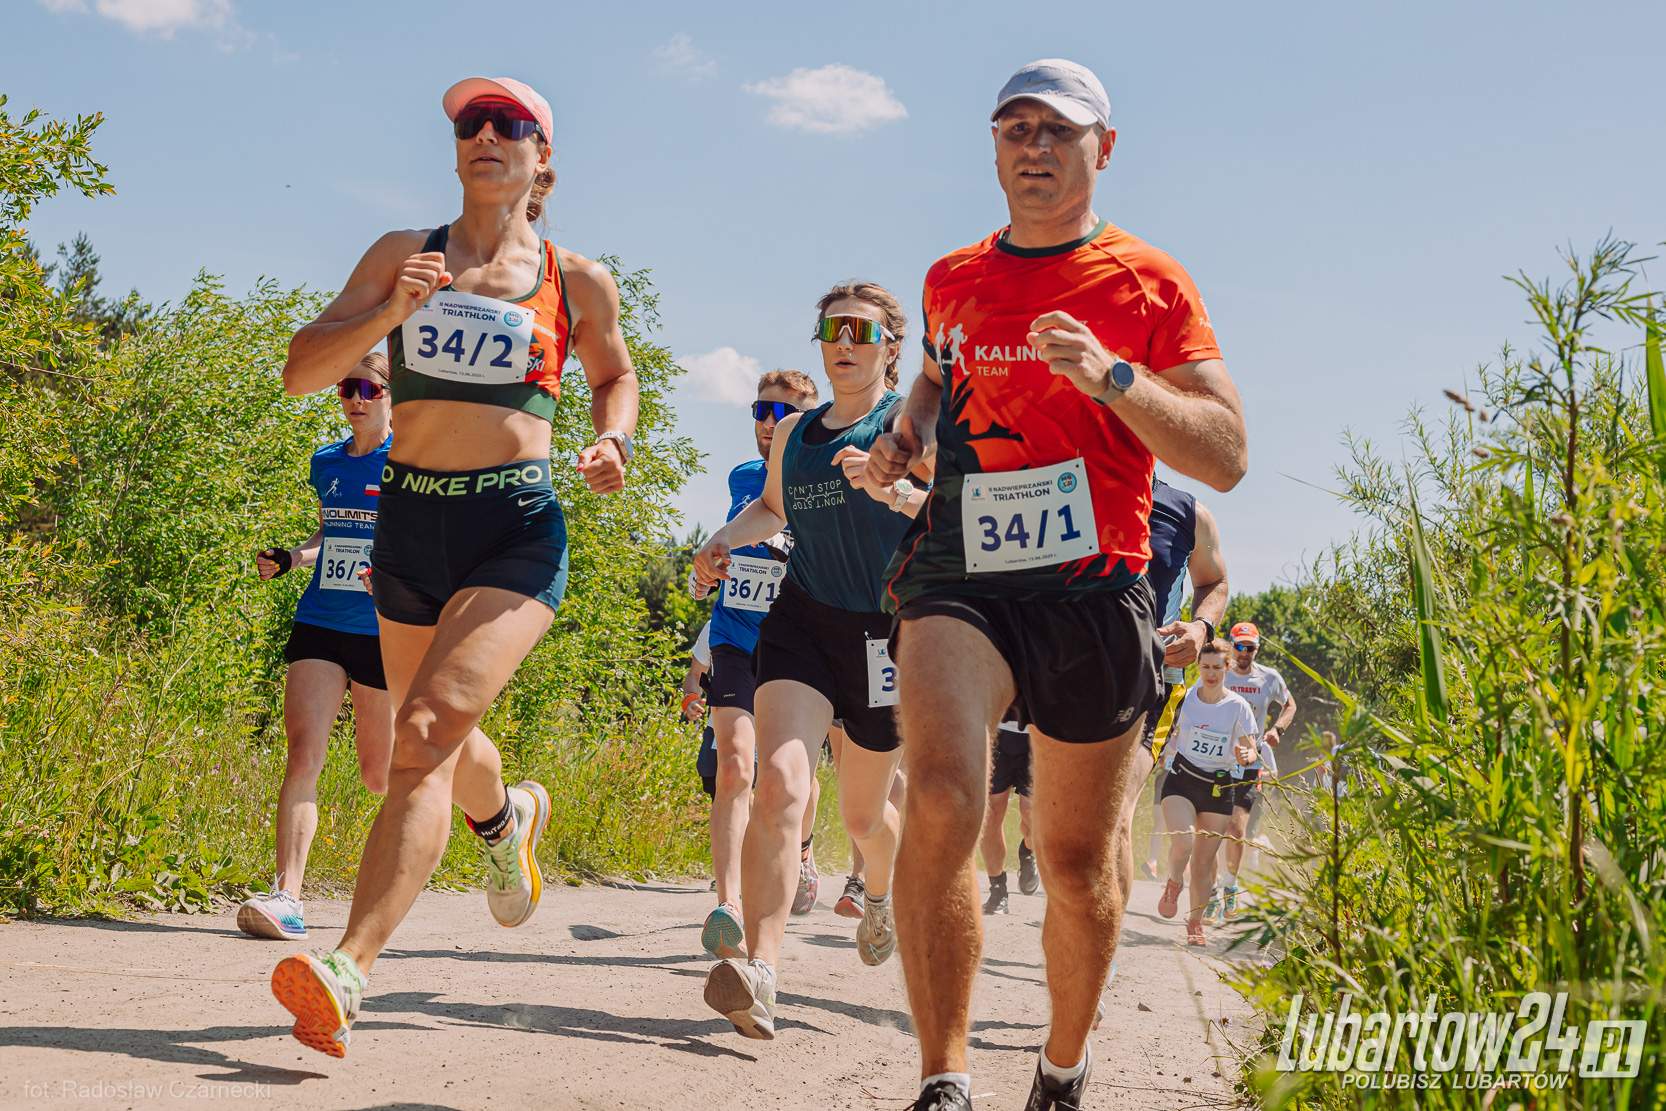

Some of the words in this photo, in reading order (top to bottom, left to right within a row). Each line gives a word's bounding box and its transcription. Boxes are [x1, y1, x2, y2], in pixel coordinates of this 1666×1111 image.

[442, 308, 496, 322] TRIATHLON
[417, 325, 513, 369] 34/2
[975, 345, 1041, 361] KALIN
[976, 366, 1009, 377] TEAM
[401, 472, 470, 496] NIKE
[475, 465, 543, 494] PRO
[788, 484, 813, 495] CAN'T
[818, 479, 842, 492] STOP
[993, 488, 1050, 502] TRIATHLON
[978, 504, 1082, 552] 34/1
[728, 576, 776, 602] 36/1
[1191, 740, 1223, 757] 25/1
